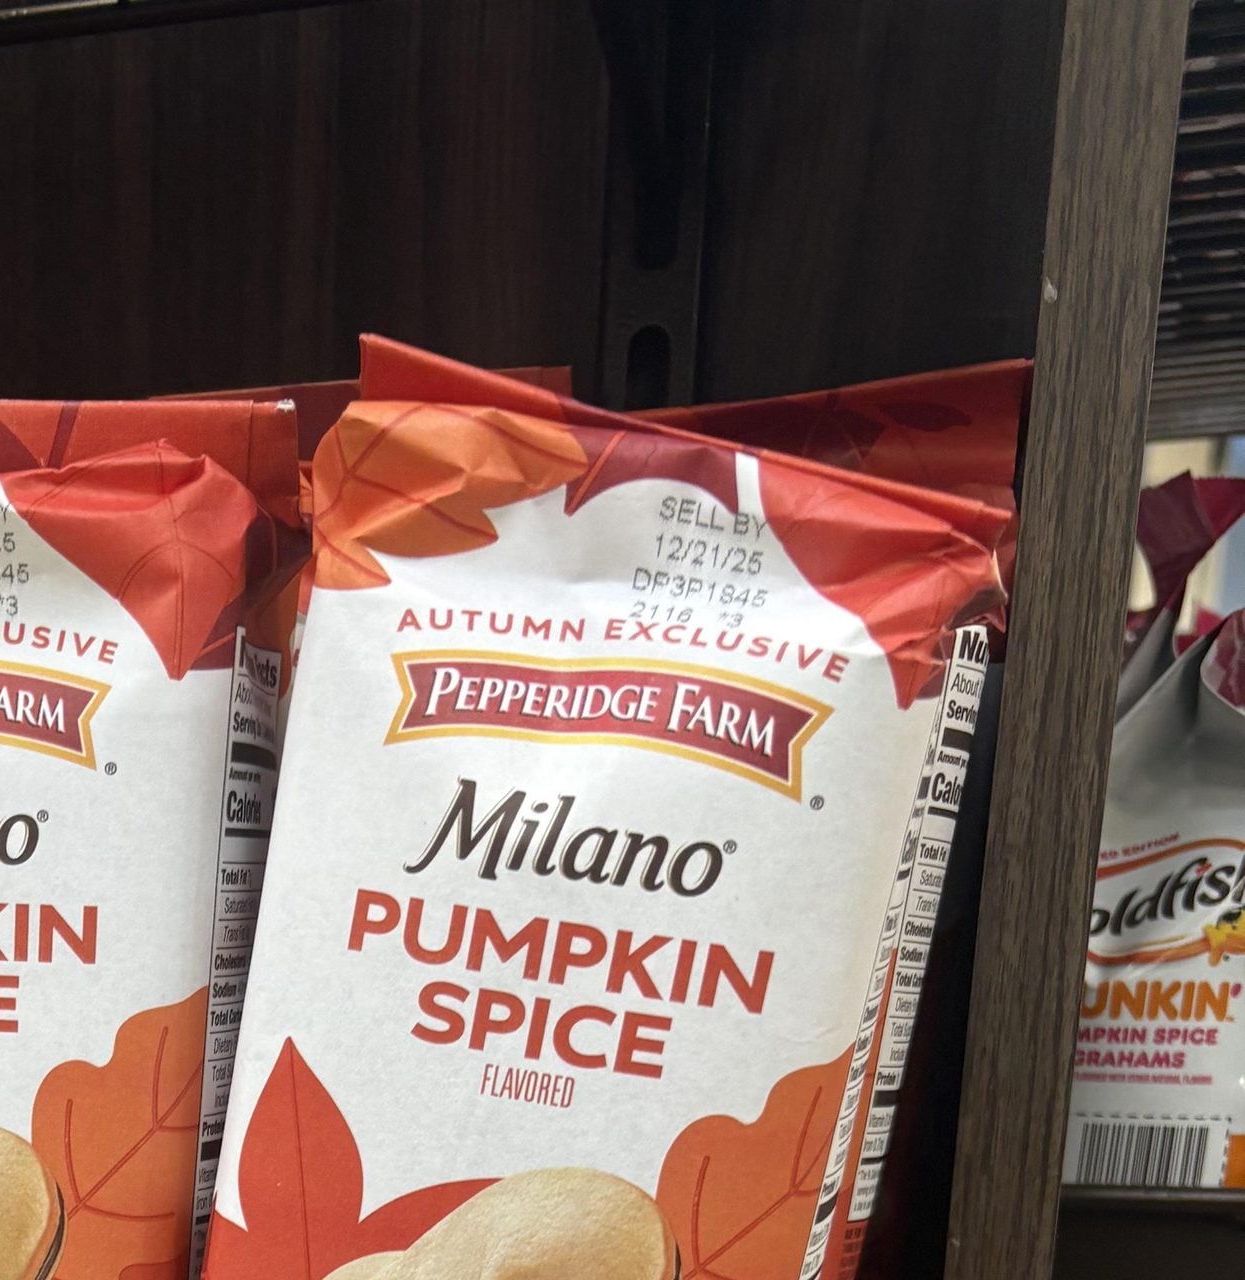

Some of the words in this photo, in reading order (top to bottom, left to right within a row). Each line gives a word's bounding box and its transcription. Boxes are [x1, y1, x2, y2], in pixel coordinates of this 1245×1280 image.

[659, 495, 724, 531] SELL
[733, 512, 767, 539] BY
[655, 532, 764, 576] 12/21/25
[631, 566, 769, 608] DP3P1845
[628, 599, 694, 624] 2116
[396, 606, 585, 644] AUTUMN
[603, 616, 851, 684] EXCLUSIVE
[423, 666, 661, 725] PEPPERIDGE
[665, 680, 776, 758] FARM
[401, 774, 724, 899] Milano
[346, 887, 776, 1017] PUMPKIN
[409, 979, 674, 1080] SPICE
[1152, 1026, 1219, 1046] SPICE
[479, 1063, 576, 1109] FLAVORED
